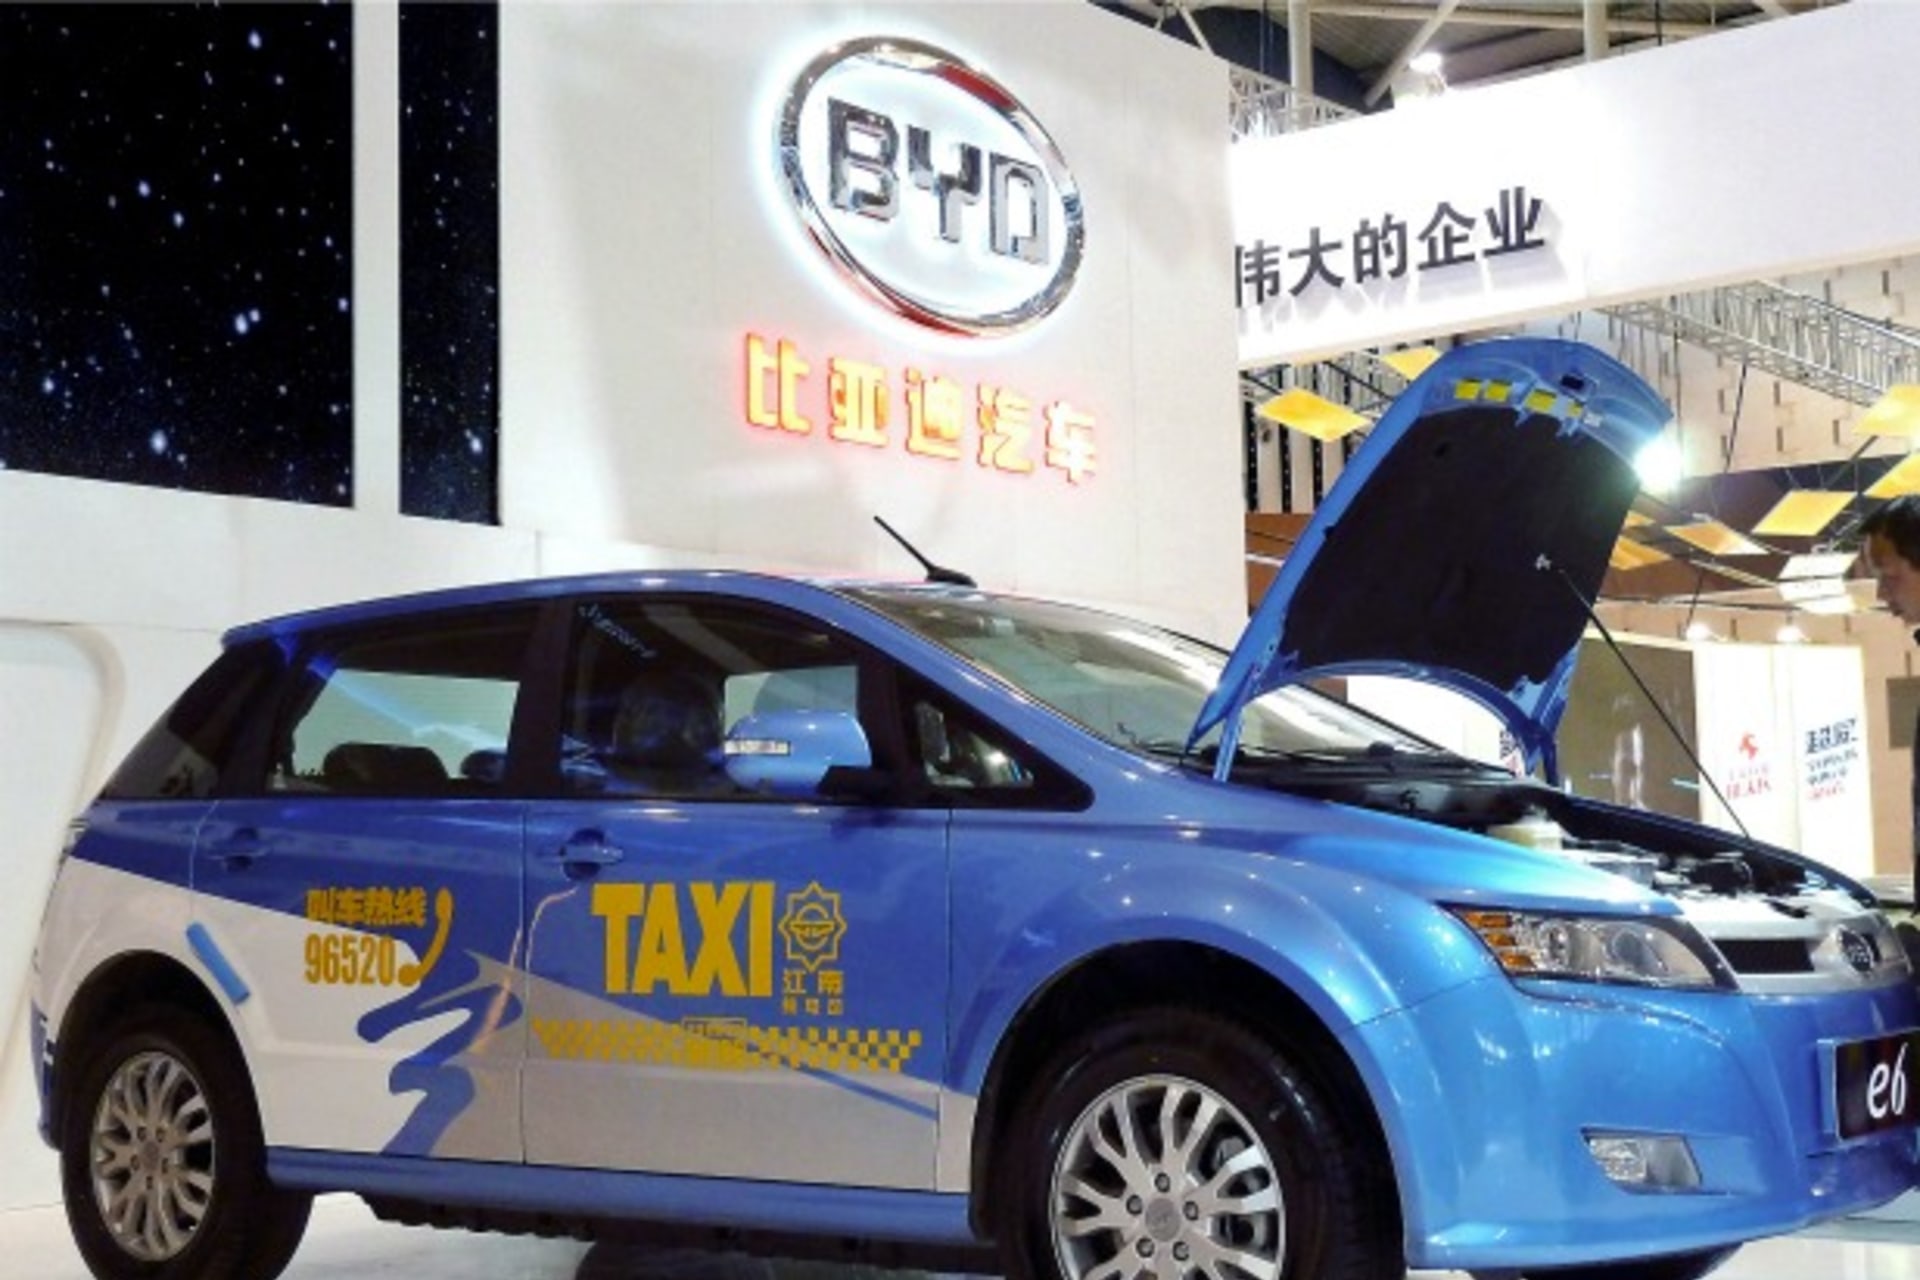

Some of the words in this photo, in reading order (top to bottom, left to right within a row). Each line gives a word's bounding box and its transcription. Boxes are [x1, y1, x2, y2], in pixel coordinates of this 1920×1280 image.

[827, 96, 1050, 265] BYD
[1234, 186, 1546, 308] 伟大的企业
[746, 333, 1097, 484] 比亚迪汽车
[304, 933, 396, 985] 96520
[306, 886, 427, 928] 叫车热线
[590, 880, 776, 997] TAXI
[1866, 1042, 1909, 1120] e6
